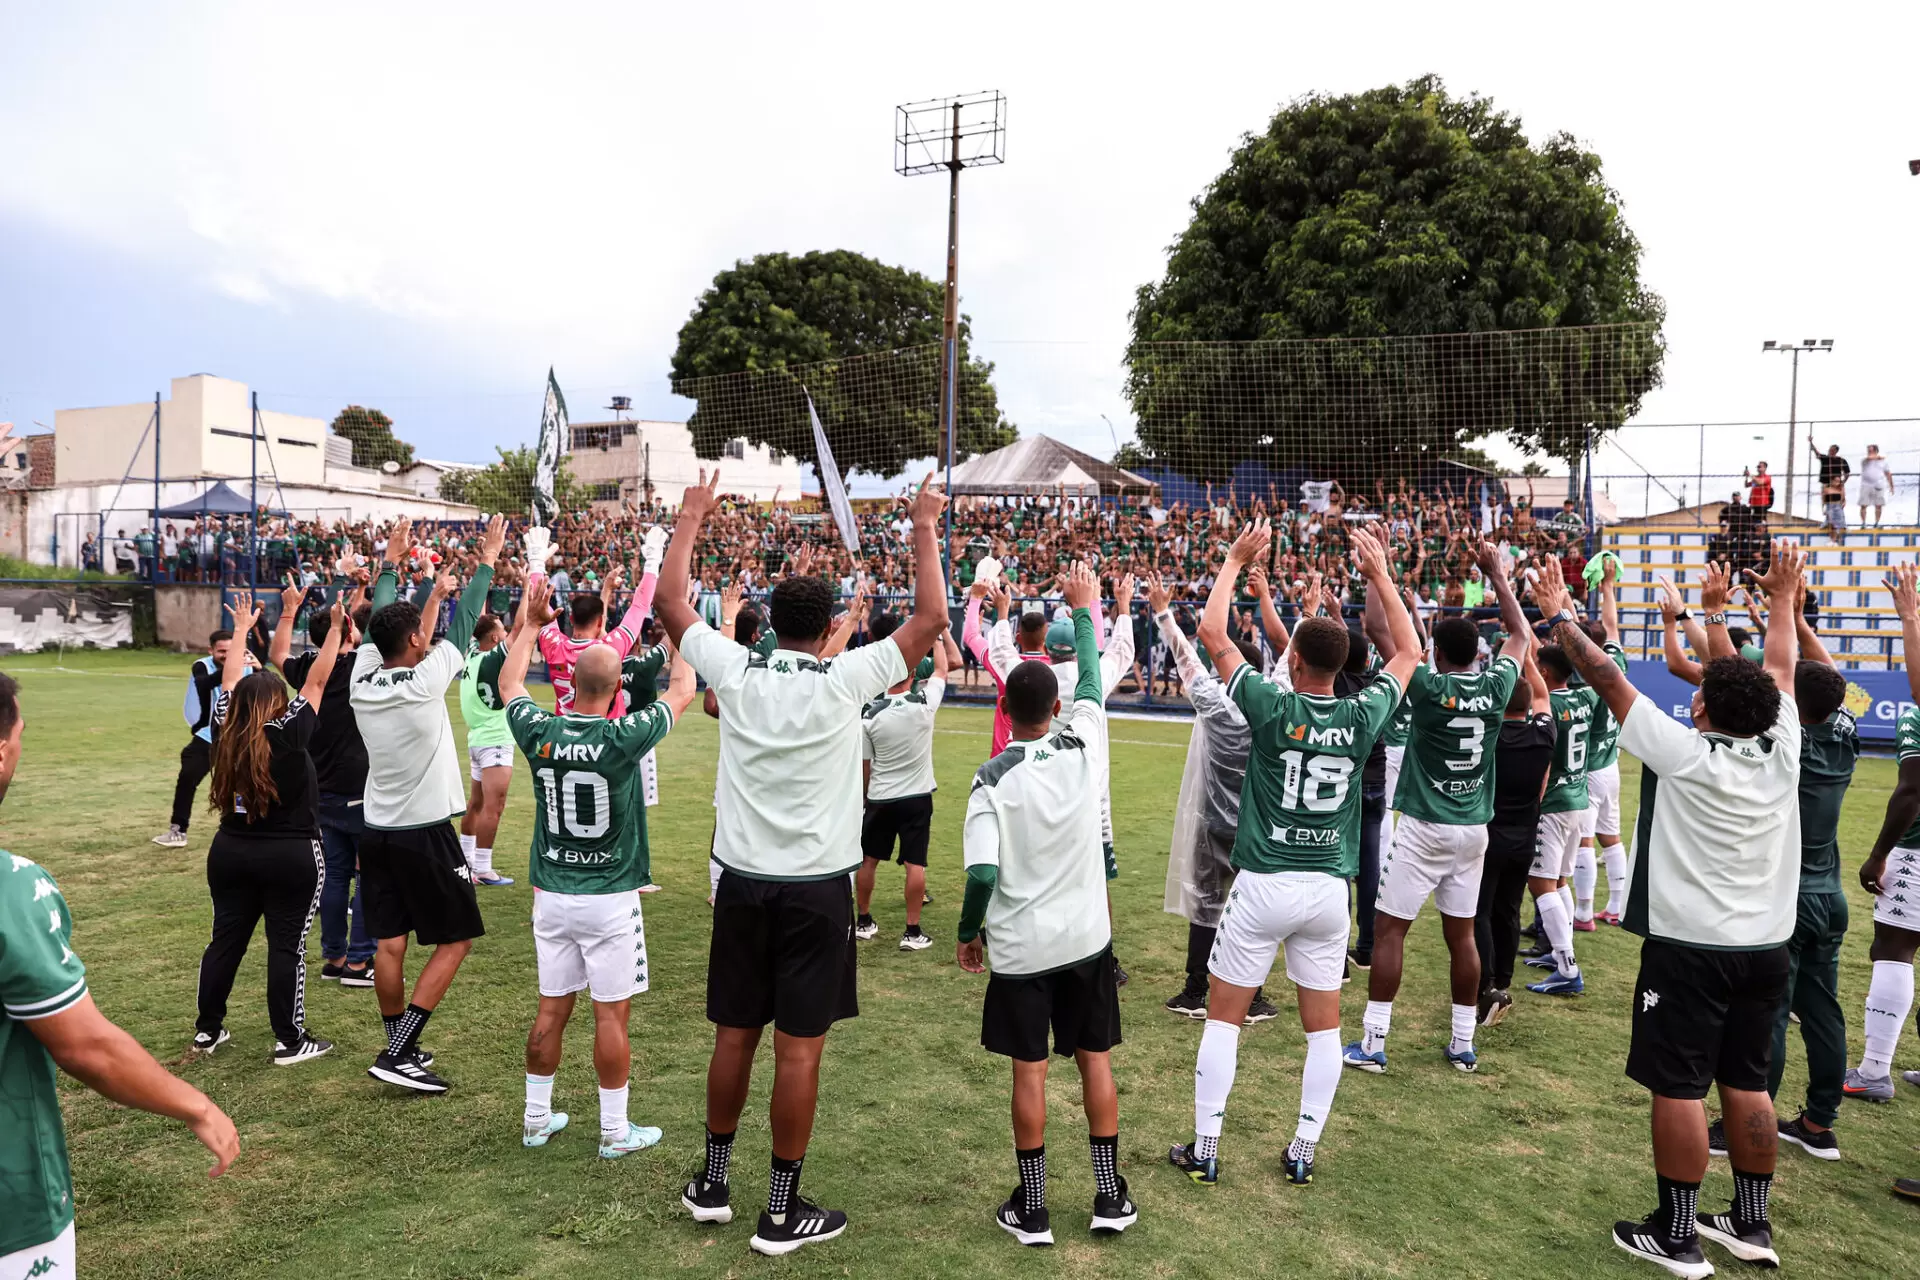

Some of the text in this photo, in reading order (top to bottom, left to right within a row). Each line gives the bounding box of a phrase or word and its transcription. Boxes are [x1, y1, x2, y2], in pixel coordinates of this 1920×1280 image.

[1459, 693, 1493, 712] MRV
[1307, 726, 1355, 746] MRV
[1446, 716, 1485, 771] 3
[553, 743, 604, 762] MRV
[1567, 722, 1588, 772] 6
[1279, 749, 1355, 812] 18
[1450, 774, 1485, 791] BVIX
[536, 767, 610, 838] 10
[1295, 826, 1340, 842] BVIX
[564, 850, 612, 864] BVIX
